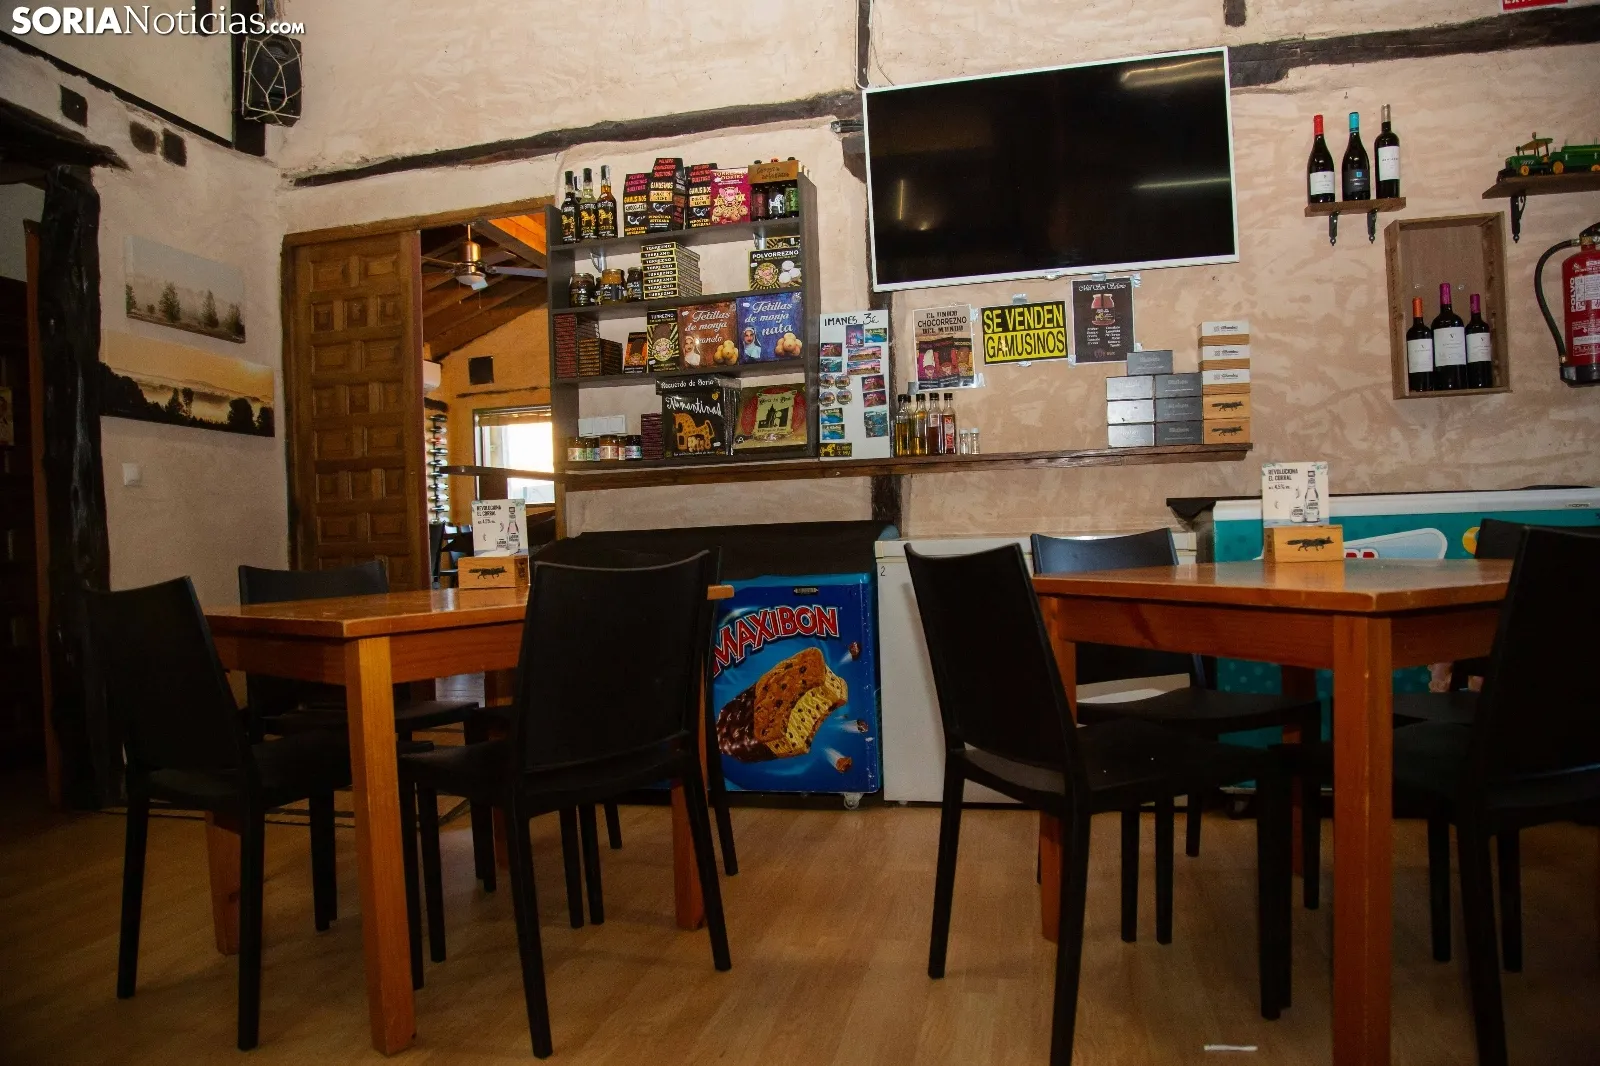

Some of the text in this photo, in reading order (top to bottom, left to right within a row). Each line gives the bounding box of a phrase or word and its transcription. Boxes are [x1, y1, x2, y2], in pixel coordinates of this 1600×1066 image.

[752, 250, 799, 259] POLVORREZNO
[752, 300, 793, 314] Tetillas
[692, 309, 731, 323] Tetillas
[744, 312, 790, 324] de monja
[824, 315, 858, 327] IMANES
[917, 316, 968, 328] CHOCORREZNO
[983, 309, 1003, 334] SE
[1005, 304, 1064, 331] VENDEN
[684, 319, 728, 333] de monja
[761, 323, 794, 336] nata
[922, 325, 964, 335] DEL MUNDO
[986, 330, 1065, 359] GAMUSINOS
[661, 381, 687, 389] Recuerdo
[880, 565, 886, 577] 2
[713, 604, 840, 678] MAXIBON
